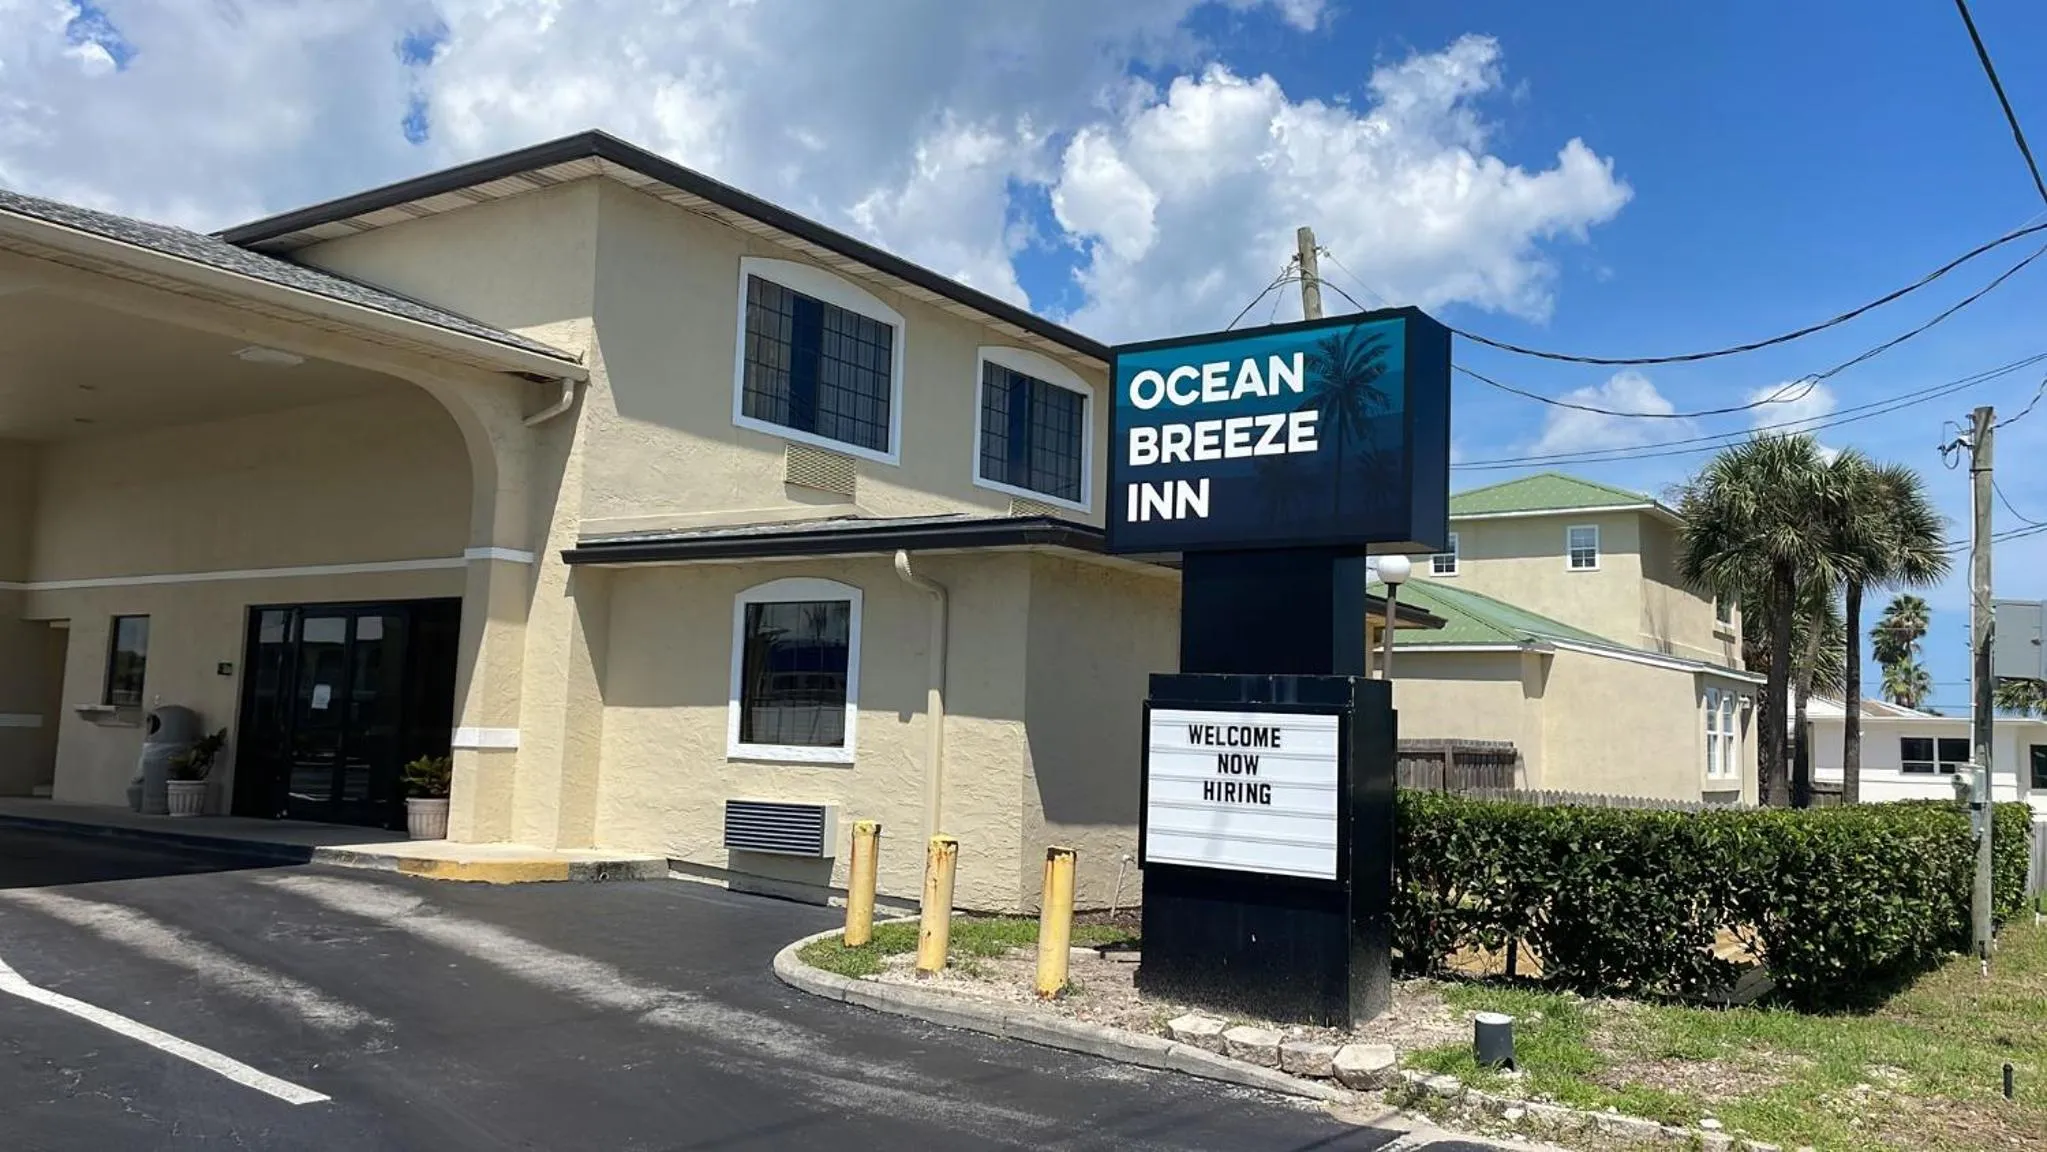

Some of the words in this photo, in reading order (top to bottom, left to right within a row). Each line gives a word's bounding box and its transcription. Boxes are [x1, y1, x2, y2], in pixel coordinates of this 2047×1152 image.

[1129, 352, 1304, 410] OCEAN
[1129, 410, 1319, 466] BREEZE
[1127, 478, 1210, 523] INN
[1188, 724, 1281, 748] WELCOME
[1217, 753, 1259, 776] NOW
[1203, 780, 1271, 805] HIRING
